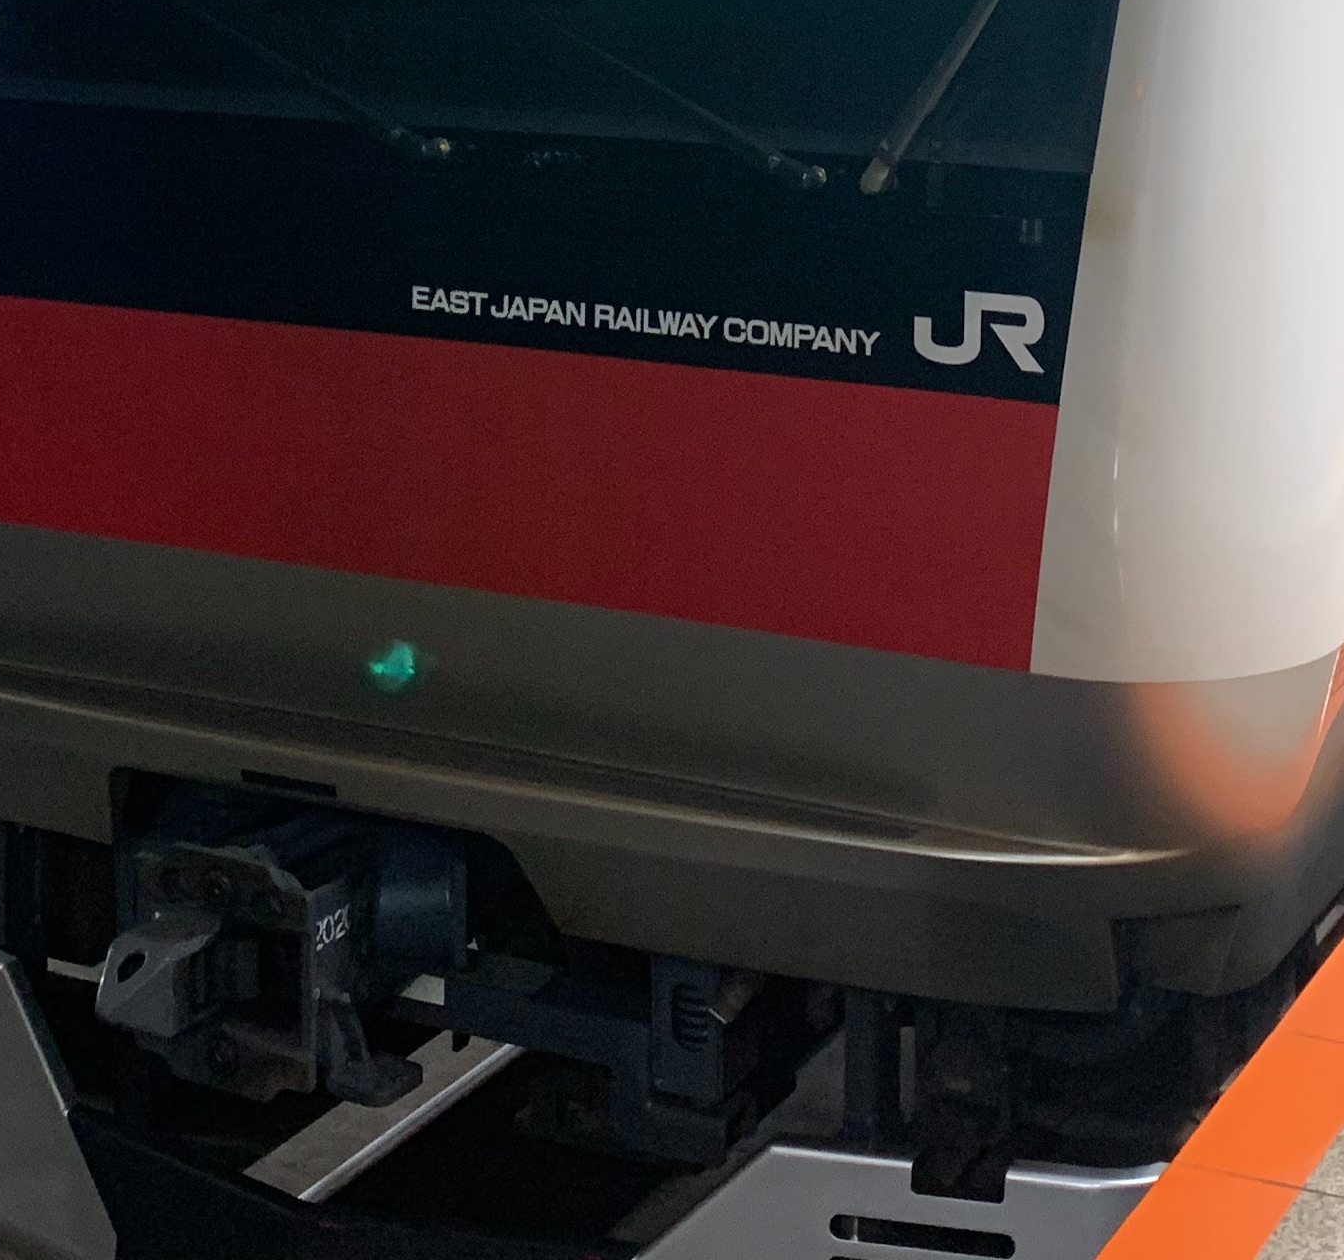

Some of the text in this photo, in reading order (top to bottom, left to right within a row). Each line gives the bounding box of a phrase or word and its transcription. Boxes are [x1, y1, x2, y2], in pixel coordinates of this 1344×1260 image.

[410, 285, 880, 357] EAST JAPAN RAILWAY COMPANY
[912, 290, 1047, 374] JR
